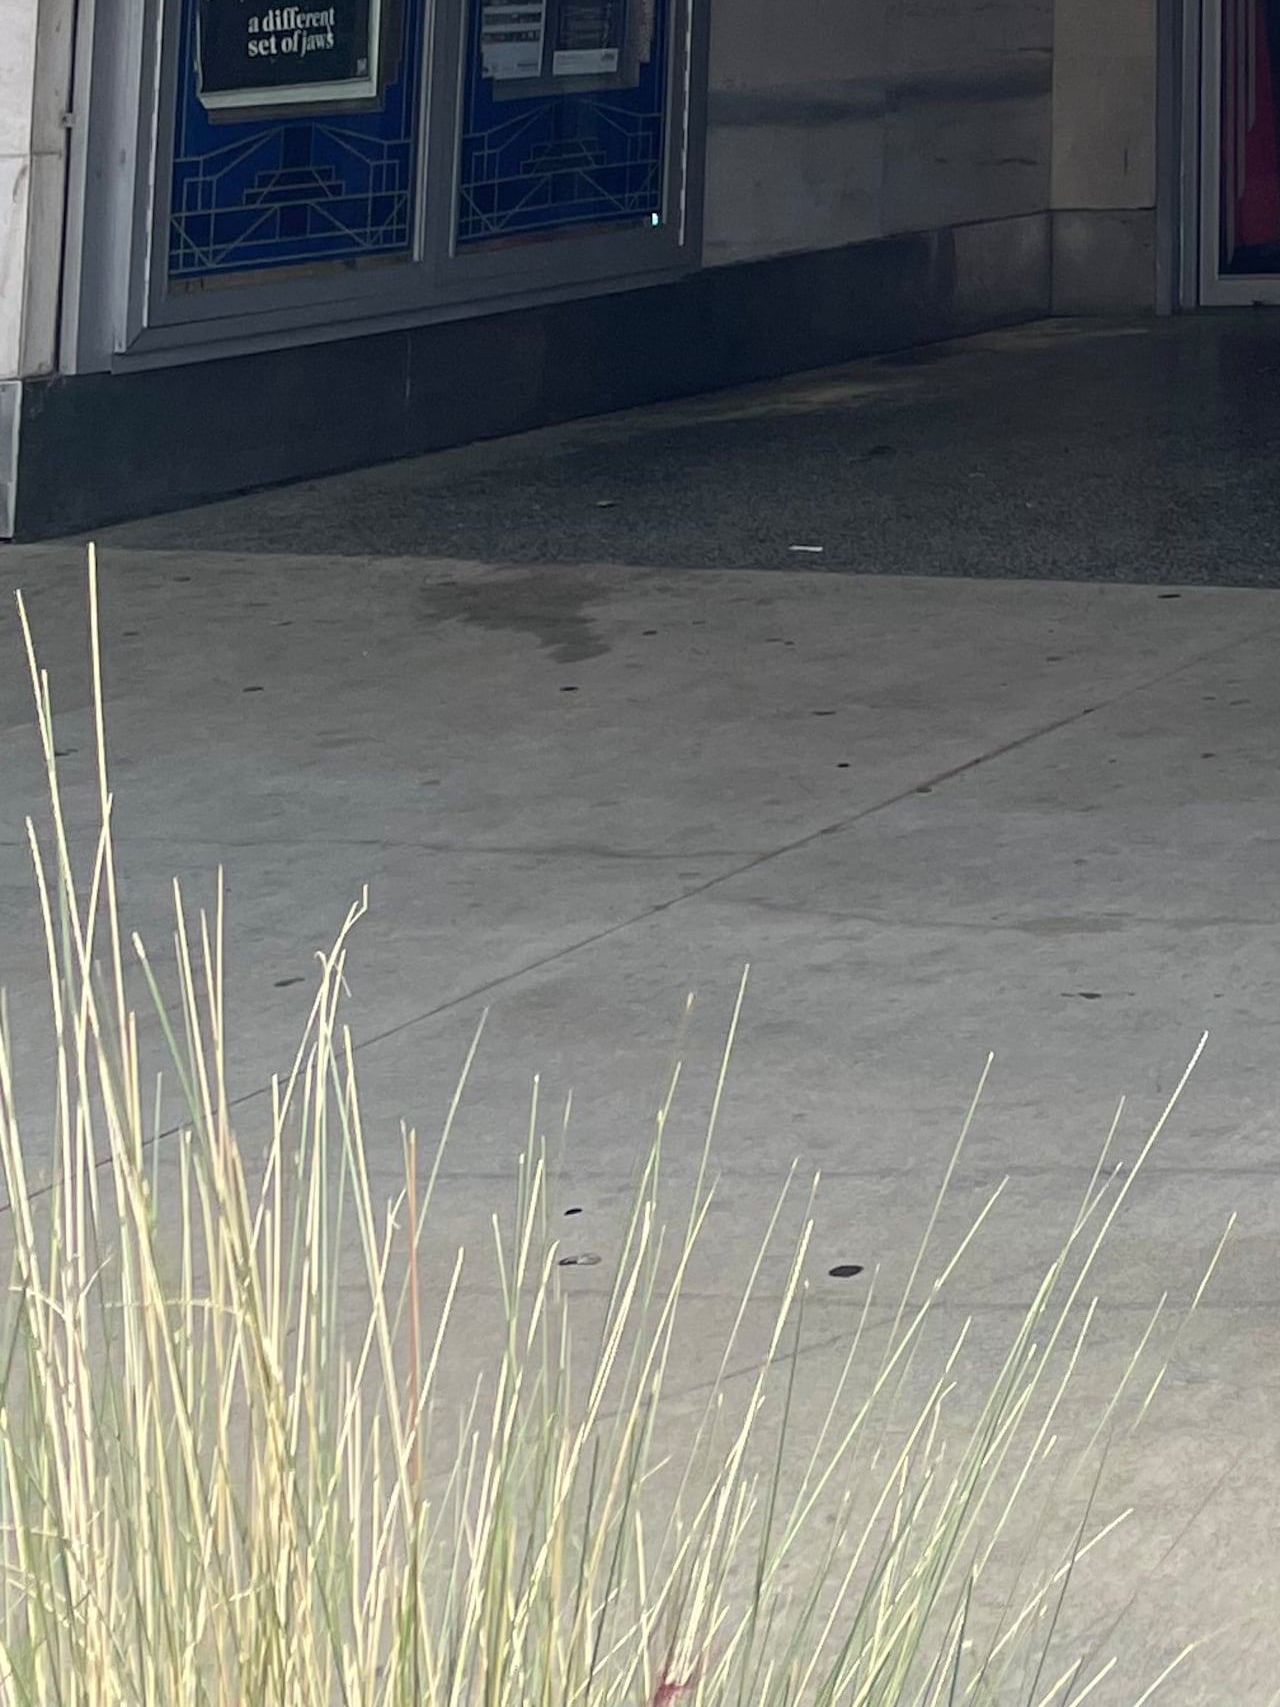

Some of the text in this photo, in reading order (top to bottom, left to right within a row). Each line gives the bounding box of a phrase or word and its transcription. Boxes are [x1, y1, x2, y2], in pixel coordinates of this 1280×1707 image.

[247, 5, 336, 33] a different
[247, 29, 335, 58] set of jaws
